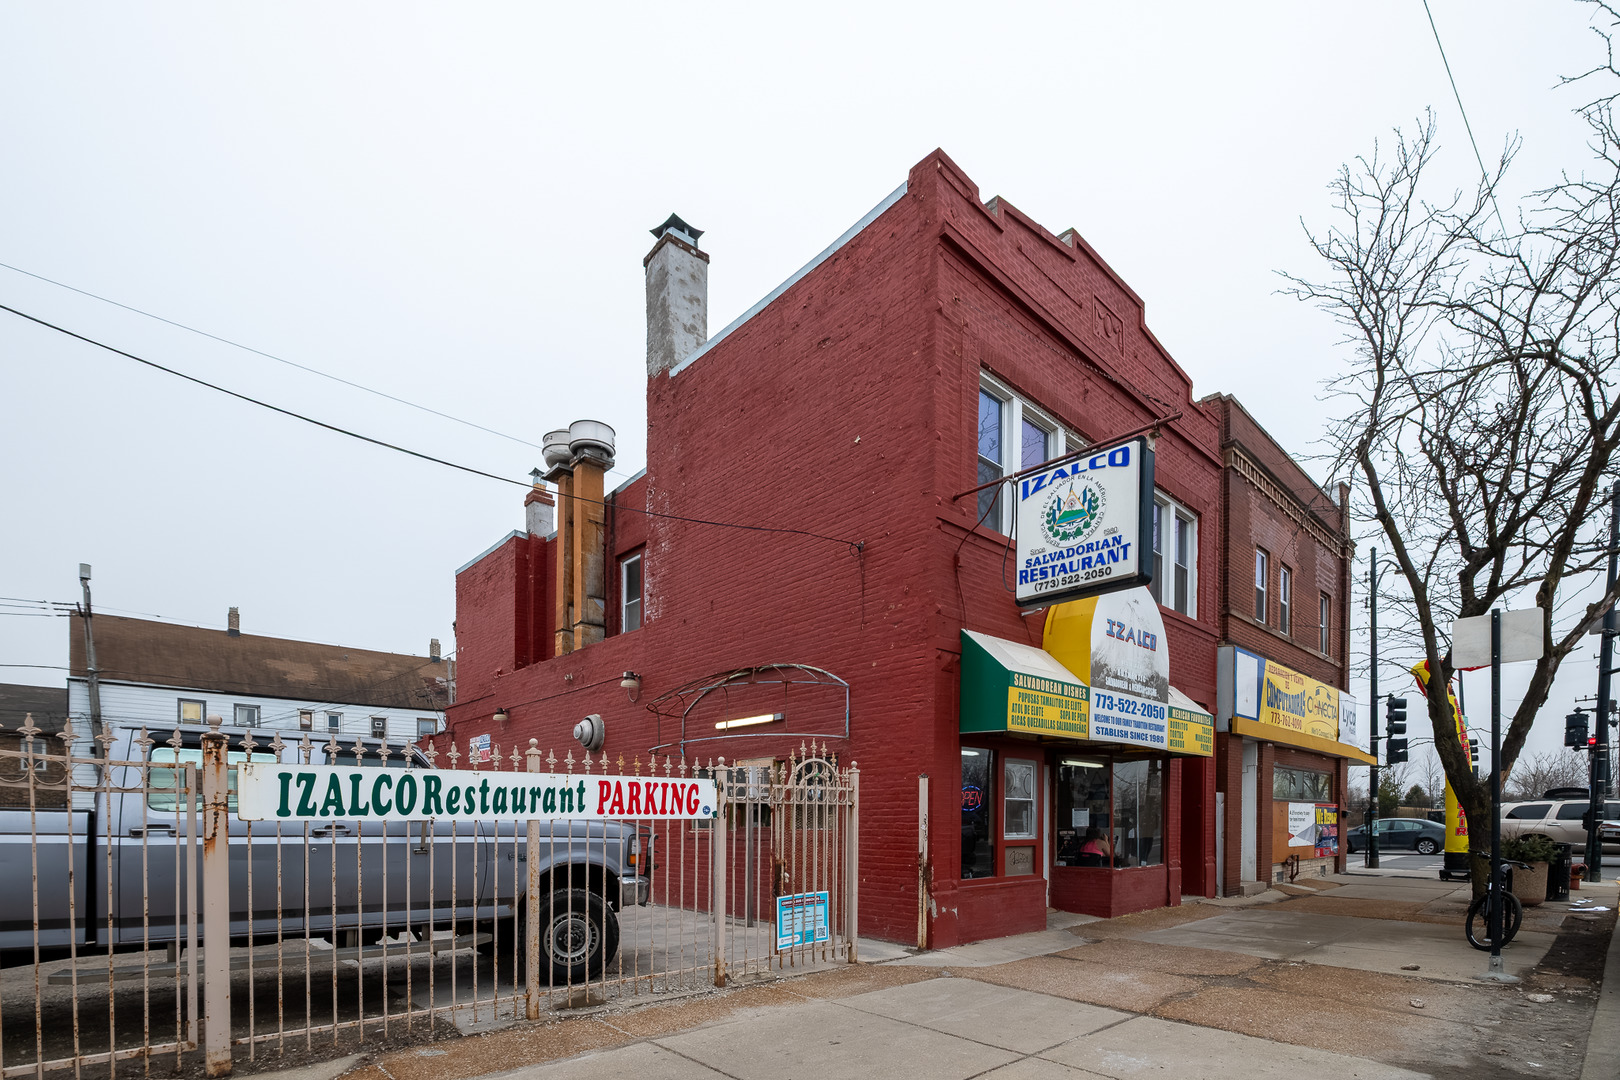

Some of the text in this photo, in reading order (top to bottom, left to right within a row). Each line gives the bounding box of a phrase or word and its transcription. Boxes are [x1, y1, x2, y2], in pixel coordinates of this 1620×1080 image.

[1022, 446, 1130, 502] IZALCO
[1047, 476, 1075, 500] SALVADOR
[1019, 542, 1131, 585] RESTAURANT
[1025, 535, 1122, 568] SALVADORIAN
[1034, 567, 1112, 592] (773) 522-2050
[1106, 618, 1157, 652] IZALCO
[1014, 673, 1062, 694] SALVADOREAN
[1064, 685, 1086, 699] DISHES
[1012, 703, 1044, 716] ATOL DE ELOTE
[1018, 692, 1039, 704] PUPUSAS
[1065, 700, 1070, 709] DE
[1071, 700, 1082, 711] ELOTE
[1095, 693, 1165, 720] 773-522-2050
[1011, 714, 1026, 726] RICAS
[1060, 710, 1070, 720] SOPA
[1072, 712, 1076, 721] DE
[1111, 716, 1115, 724] TO
[1096, 726, 1128, 738] STABLISH
[1130, 731, 1148, 741] SINCE
[596, 780, 700, 816] PARKING
